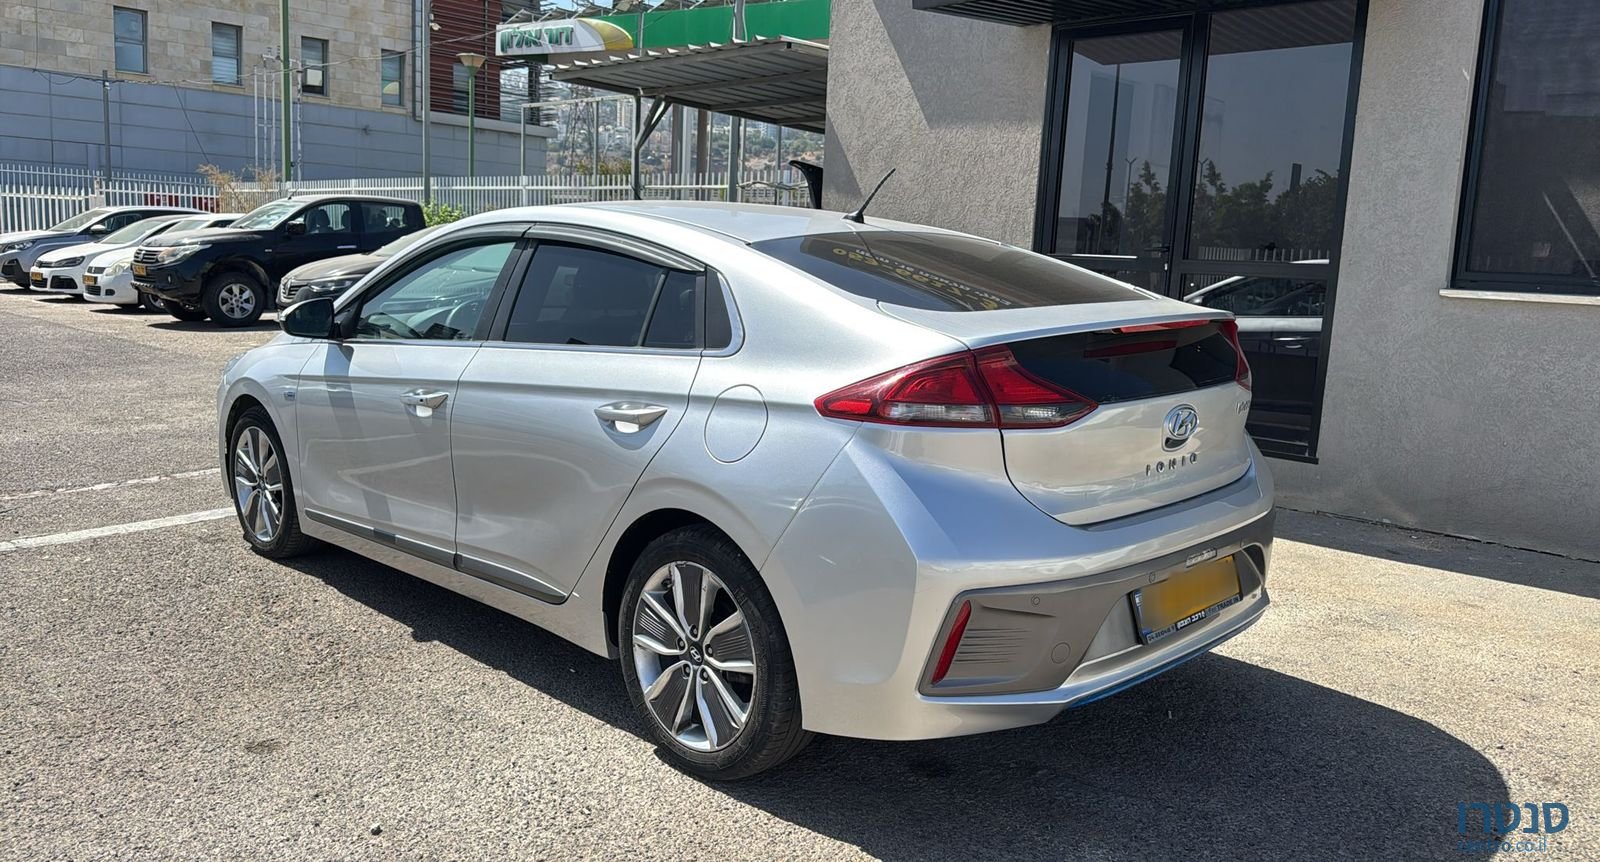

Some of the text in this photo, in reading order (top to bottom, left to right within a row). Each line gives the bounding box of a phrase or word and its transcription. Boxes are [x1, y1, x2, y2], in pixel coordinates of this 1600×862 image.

[500, 25, 574, 53] דור אלון
[1145, 453, 1198, 477] IONIQ
